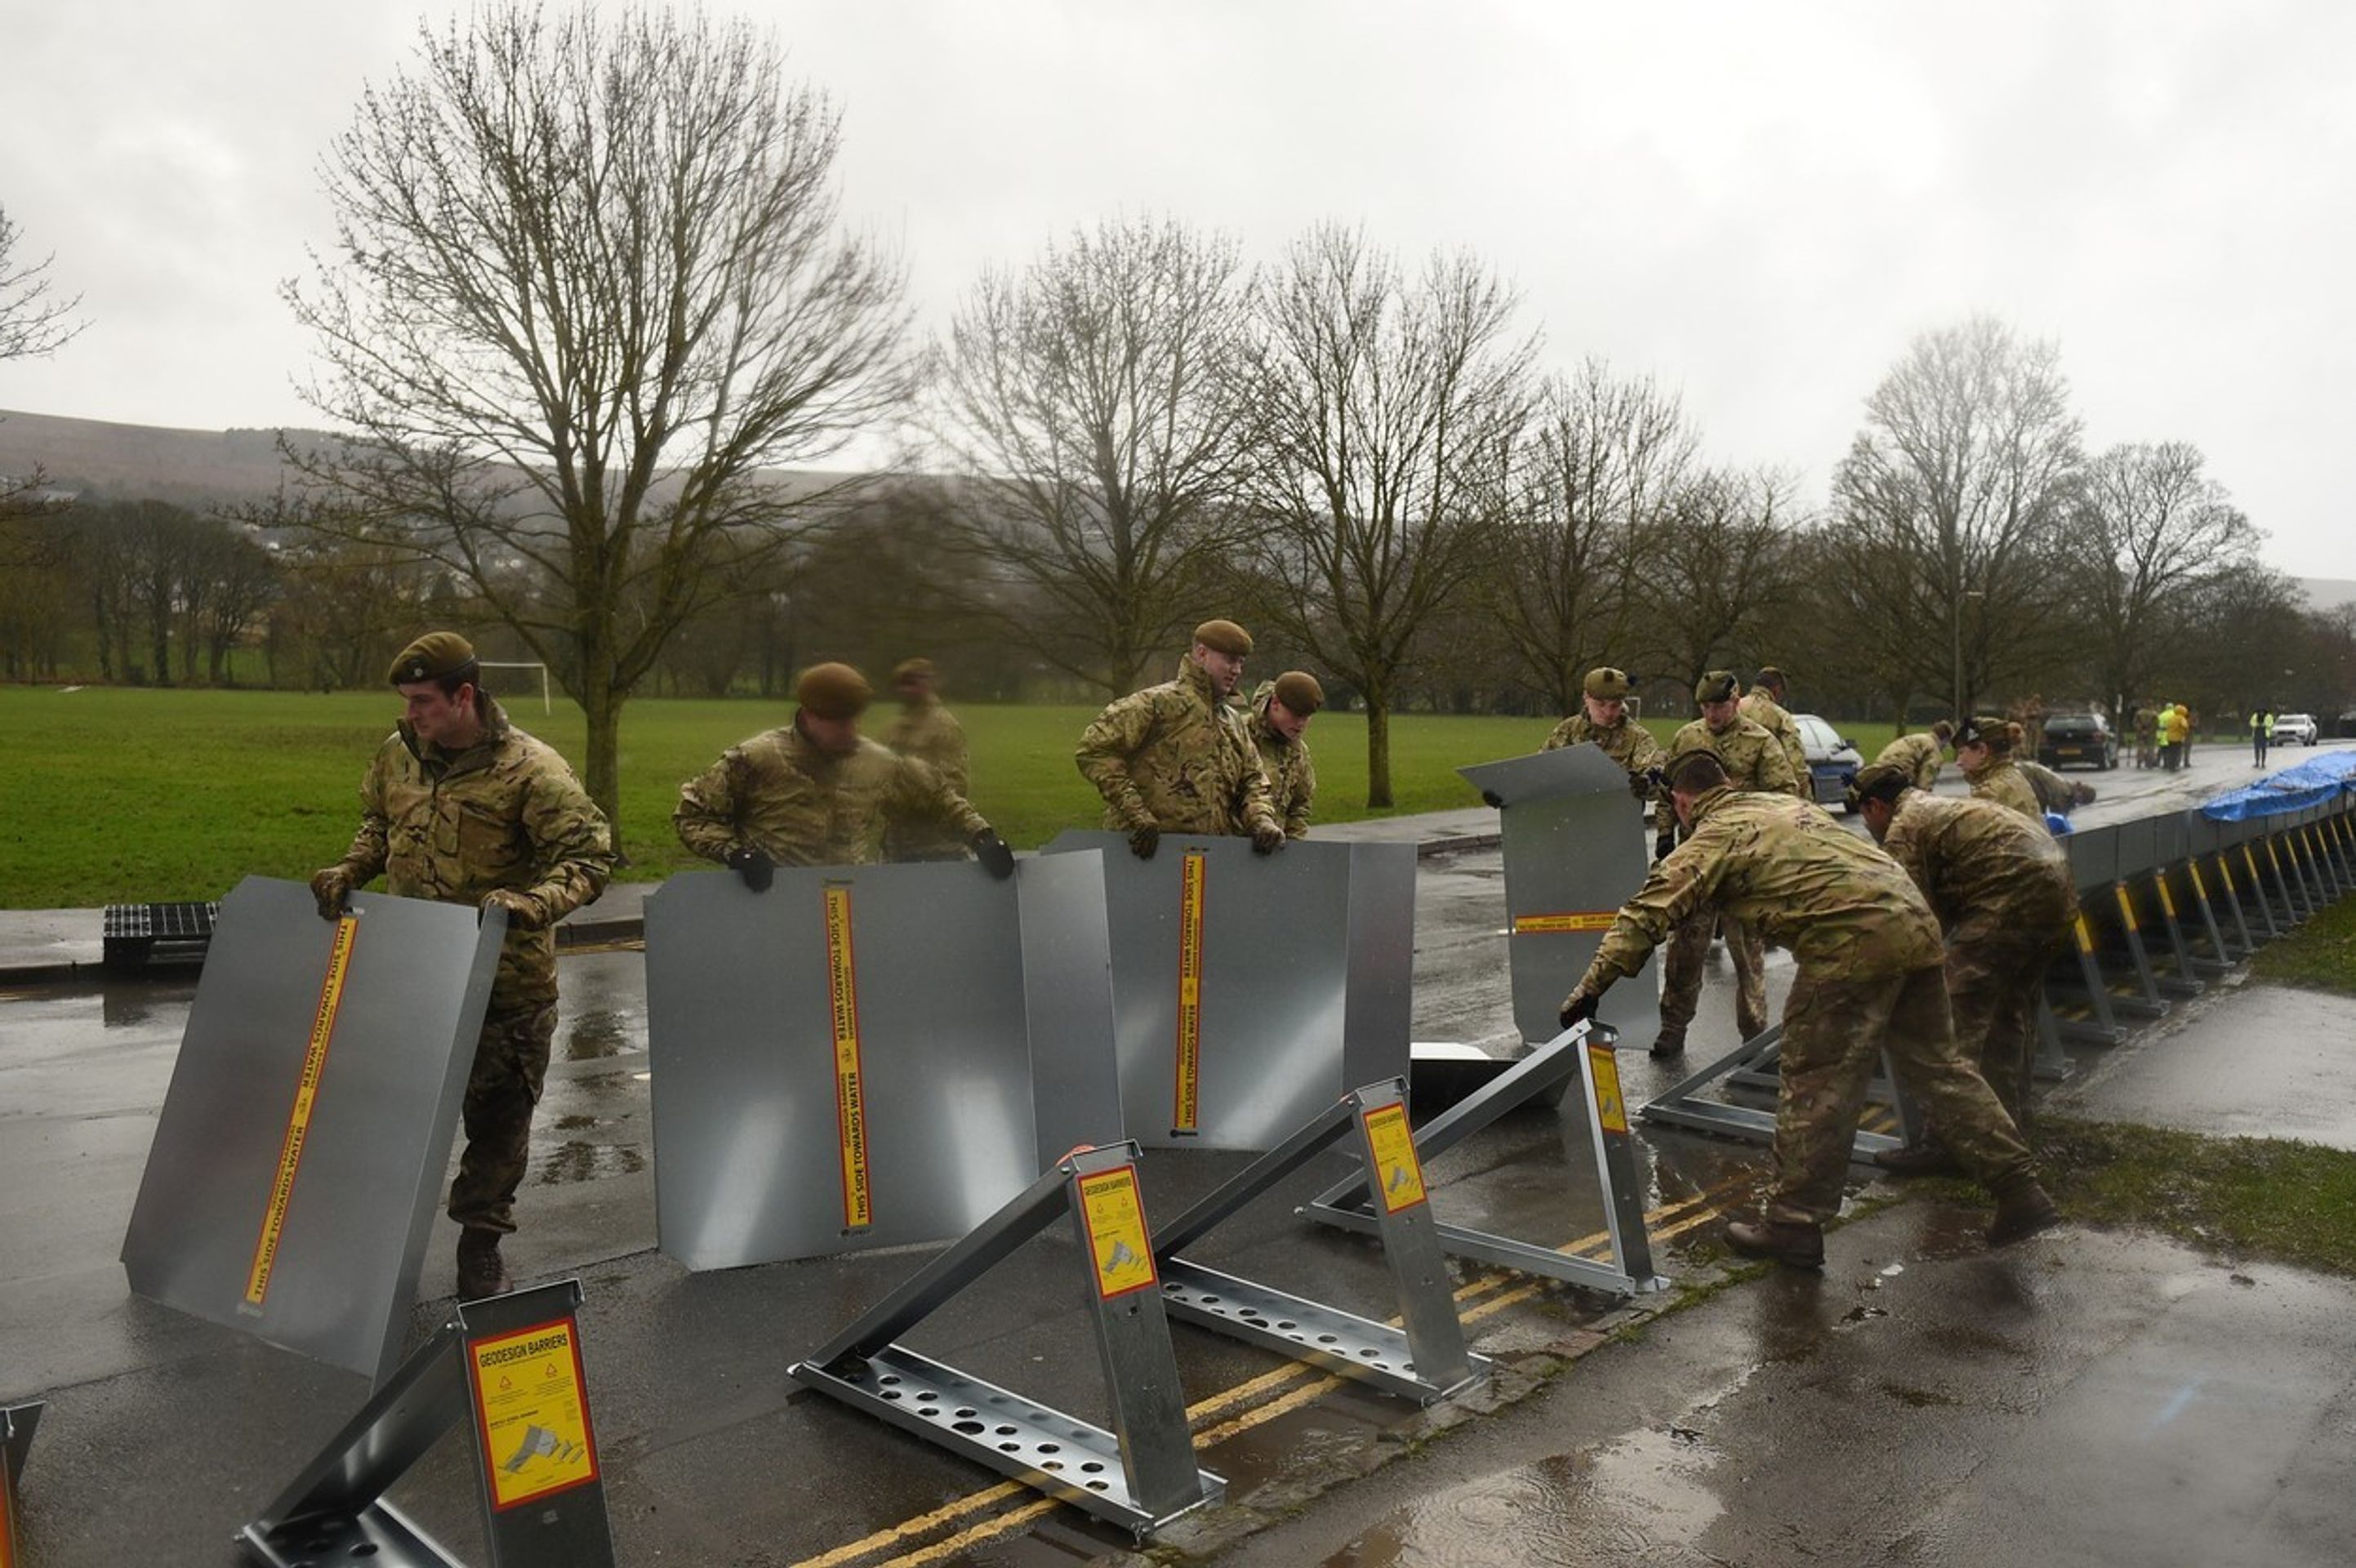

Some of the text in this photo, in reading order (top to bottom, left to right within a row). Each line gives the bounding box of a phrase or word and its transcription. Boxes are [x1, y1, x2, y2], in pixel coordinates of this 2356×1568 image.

[337, 924, 348, 950] THIS
[328, 954, 341, 979] SIDE
[829, 896, 848, 1041] THIS SIDE TOWARDS WATER
[314, 984, 334, 1042] TOWARDS
[302, 1047, 318, 1089] WATER
[848, 1071, 866, 1219] THIS SIDE TOWARDS WATER
[255, 1267, 268, 1295] THIS
[263, 1236, 275, 1264] SIDE
[271, 1173, 292, 1232] TOWARDS
[287, 1125, 304, 1168] WATER
[479, 1343, 528, 1368] GEODESIGN
[528, 1333, 568, 1356] BARRIERS
